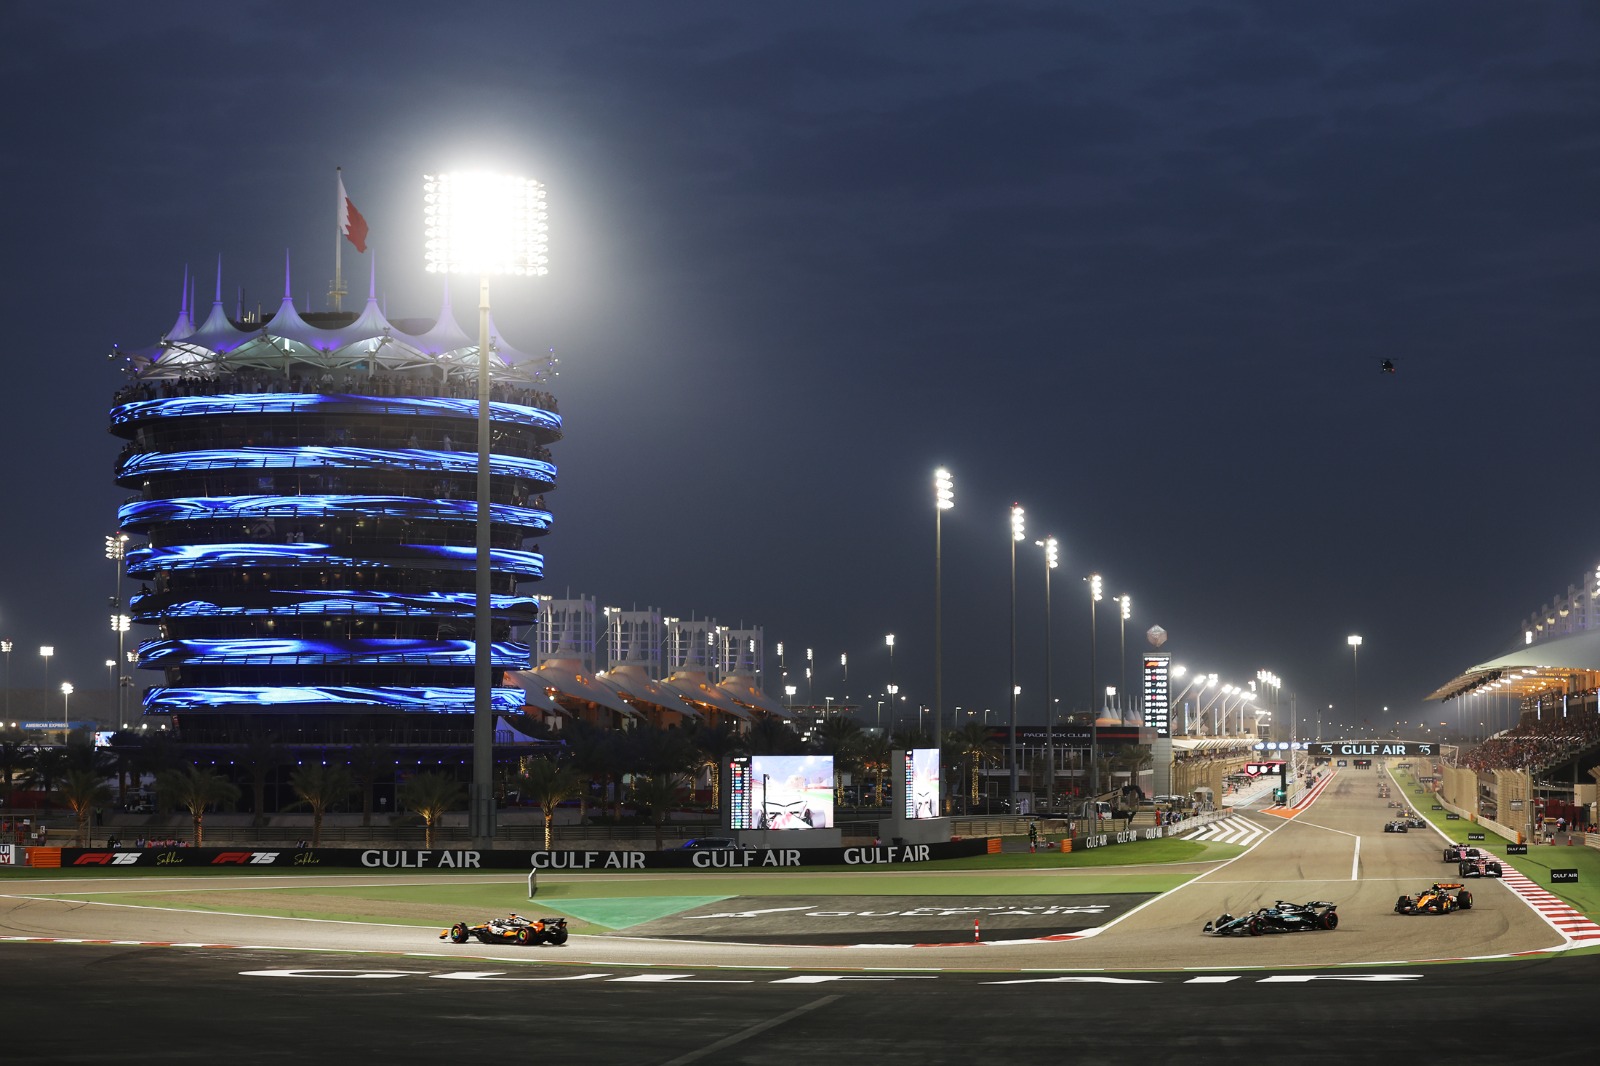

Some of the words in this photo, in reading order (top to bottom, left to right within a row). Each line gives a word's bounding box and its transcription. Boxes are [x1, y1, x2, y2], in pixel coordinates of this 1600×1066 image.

[1321, 744, 1333, 756] 75
[1341, 744, 1379, 755] GULF
[1382, 744, 1406, 755] AIR
[1419, 744, 1431, 756] 75
[1117, 831, 1129, 844] GULF
[1128, 830, 1137, 841] AIR
[1145, 828, 1157, 839] GULF
[1086, 836, 1099, 849] GULF
[1099, 834, 1107, 846] AIR
[156, 852, 183, 865] Sakhir
[294, 851, 320, 865] Sakhir
[360, 850, 432, 868] GULF
[437, 850, 481, 868] AIR
[530, 851, 599, 868] GULF
[604, 851, 646, 868] AIR
[692, 851, 757, 868] GULF
[762, 849, 801, 867] AIR
[843, 847, 898, 865] GULF
[902, 844, 930, 862] AIR
[805, 909, 980, 917] GULF
[238, 968, 938, 984] GULF
[978, 974, 1424, 984] AIR
